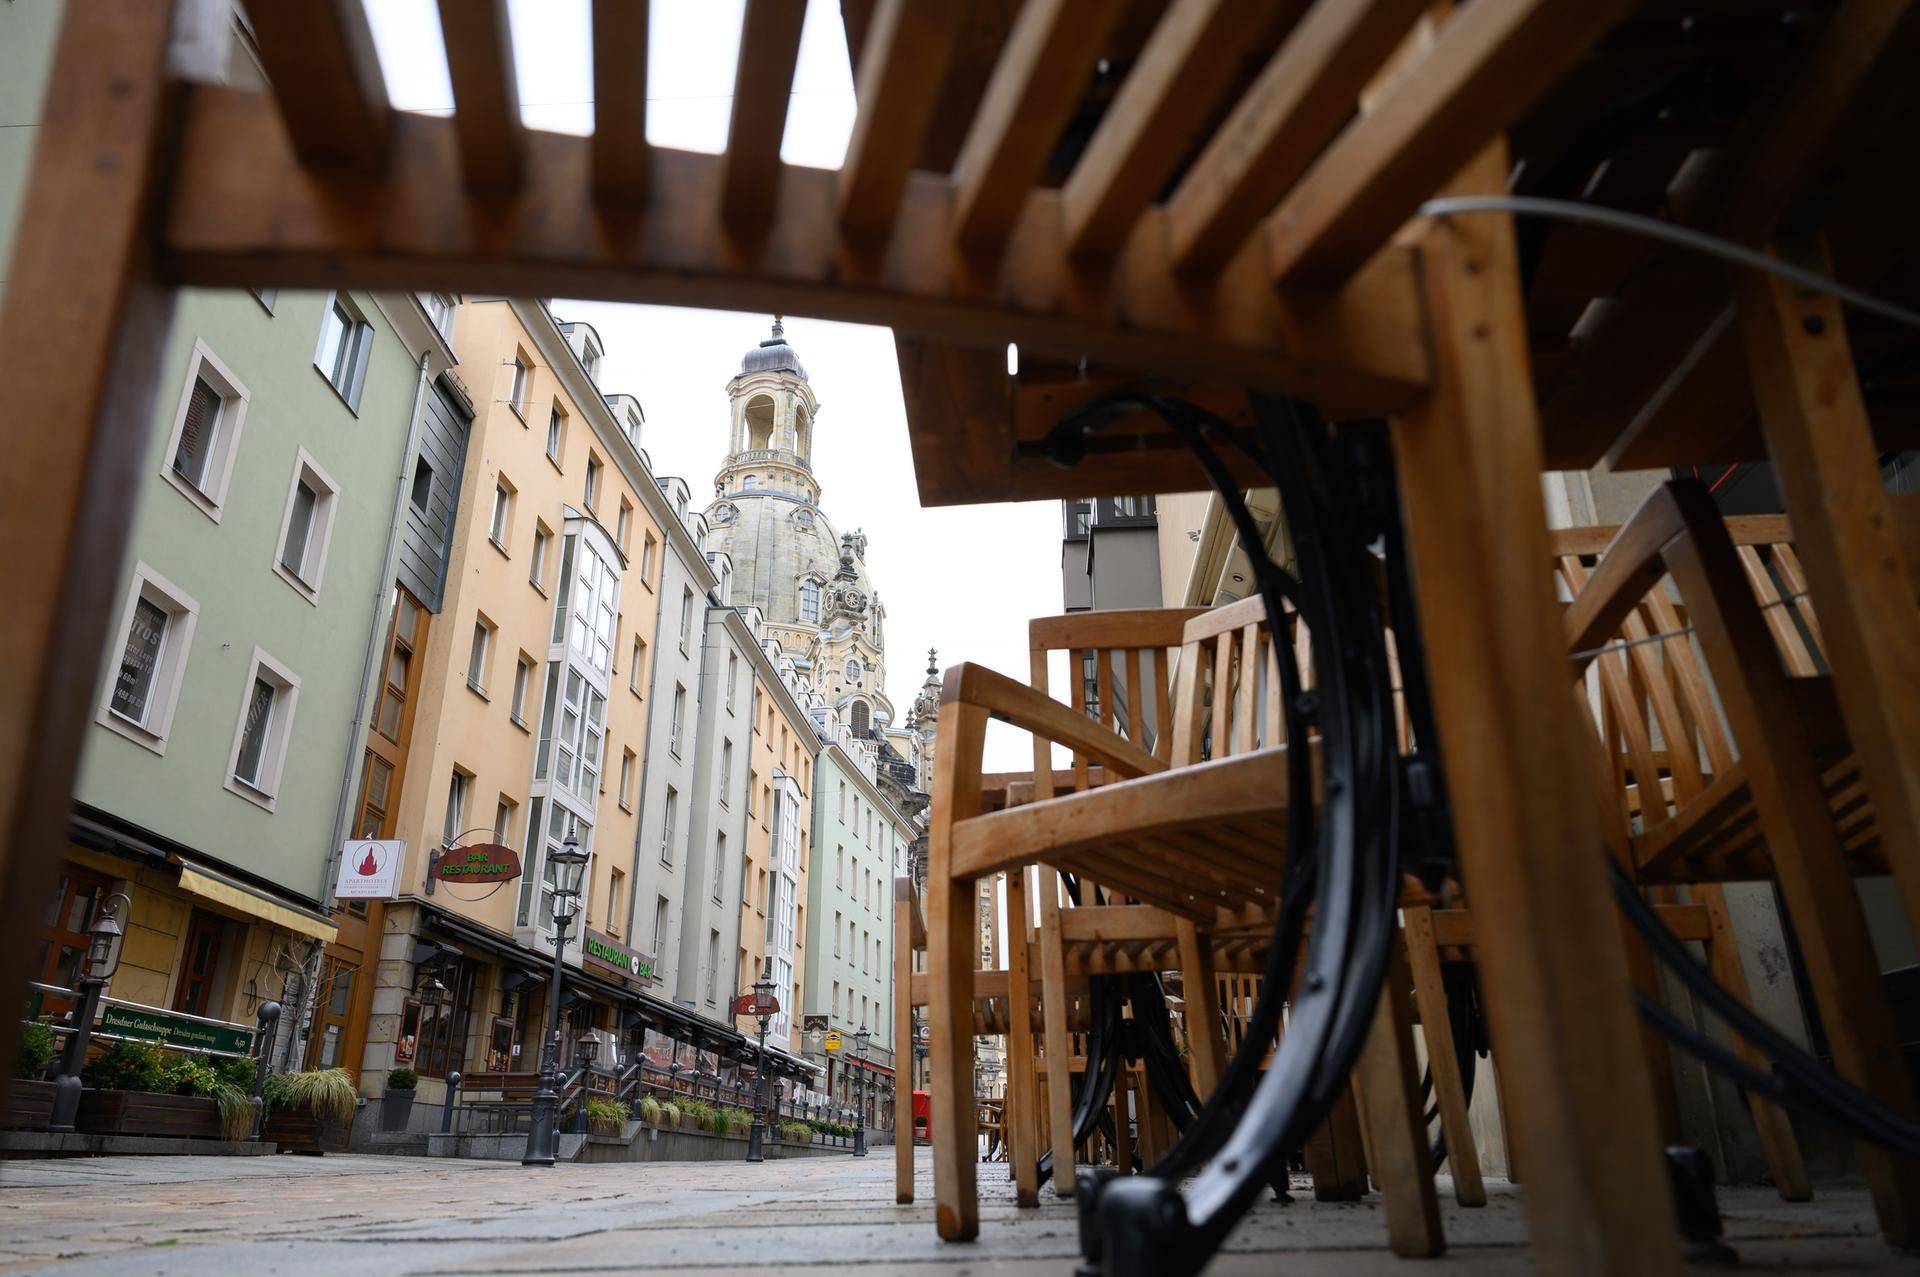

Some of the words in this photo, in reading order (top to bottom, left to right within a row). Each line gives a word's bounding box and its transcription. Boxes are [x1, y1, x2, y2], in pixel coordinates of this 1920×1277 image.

[467, 852, 488, 861] BAR
[442, 864, 510, 874] RESTAURANT
[588, 937, 630, 969] RESTAURANT
[640, 960, 652, 979] BAR
[105, 1013, 133, 1028] Dresdner
[134, 1019, 172, 1037] Gulaschsuppe
